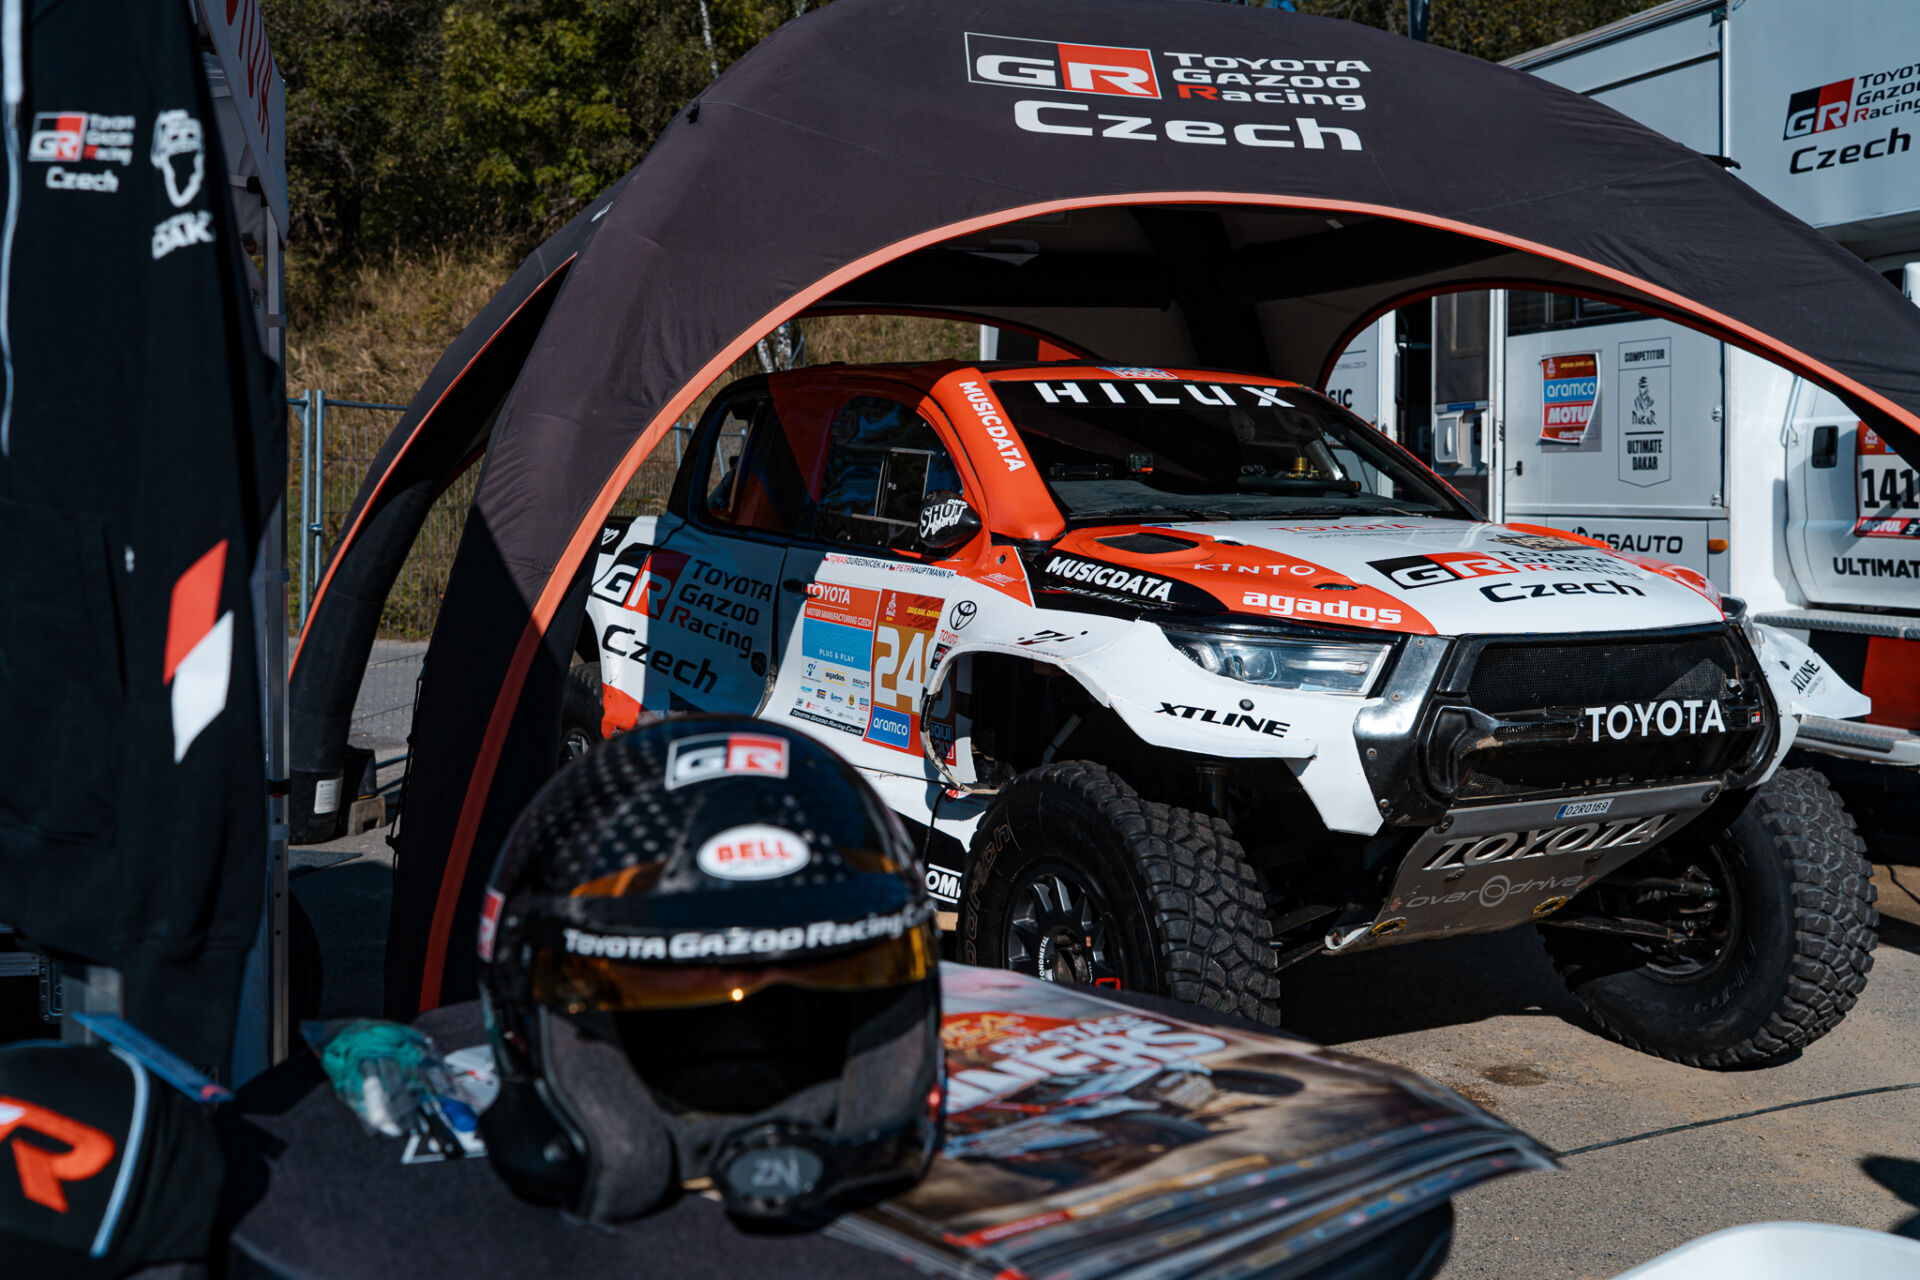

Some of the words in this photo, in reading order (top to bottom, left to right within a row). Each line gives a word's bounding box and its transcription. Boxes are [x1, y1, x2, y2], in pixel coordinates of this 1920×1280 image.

[976, 54, 1153, 95] GR
[1163, 51, 1372, 72] TOYOTA
[1172, 68, 1361, 89] GAZOO
[1177, 84, 1367, 111] Racing
[1014, 99, 1363, 151] Czech
[1785, 100, 1848, 139] GR
[1789, 126, 1912, 175] Czech
[1624, 349, 1665, 362] COMPETITOR
[1034, 382, 1296, 408] HILUX
[1326, 388, 1353, 409] SIC
[1547, 382, 1596, 398] aramco
[958, 381, 1027, 472] MUSICDATA
[1627, 439, 1662, 454] ULTIMATE
[1632, 456, 1658, 470] DAKAR
[920, 503, 966, 538] SHOT
[1860, 520, 1902, 532] MOTUL
[1391, 559, 1518, 586] GR
[1488, 550, 1618, 565] TOYOTA
[1522, 563, 1646, 582] Racing
[592, 564, 672, 620] GR
[693, 559, 773, 602] TOYOTA
[806, 583, 850, 605] TOYOTA
[1045, 556, 1173, 602] MUSICDATA
[1479, 579, 1646, 603] Czech
[678, 584, 759, 626] GAZOO
[1242, 591, 1402, 624] agados
[669, 605, 753, 659] Racing
[601, 624, 718, 694] Czech
[873, 625, 935, 713] 24
[1790, 659, 1820, 695] XTLINE
[873, 717, 908, 736] aramco
[1154, 700, 1291, 738] XTLINE
[1585, 699, 1727, 743] TOYOTA
[676, 745, 782, 775] GR
[717, 840, 792, 863] BELL
[1421, 812, 1679, 871] TOYOTA
[563, 929, 667, 959] TOYOTA
[668, 926, 806, 958] GAZOO
[804, 912, 903, 948] Racing
